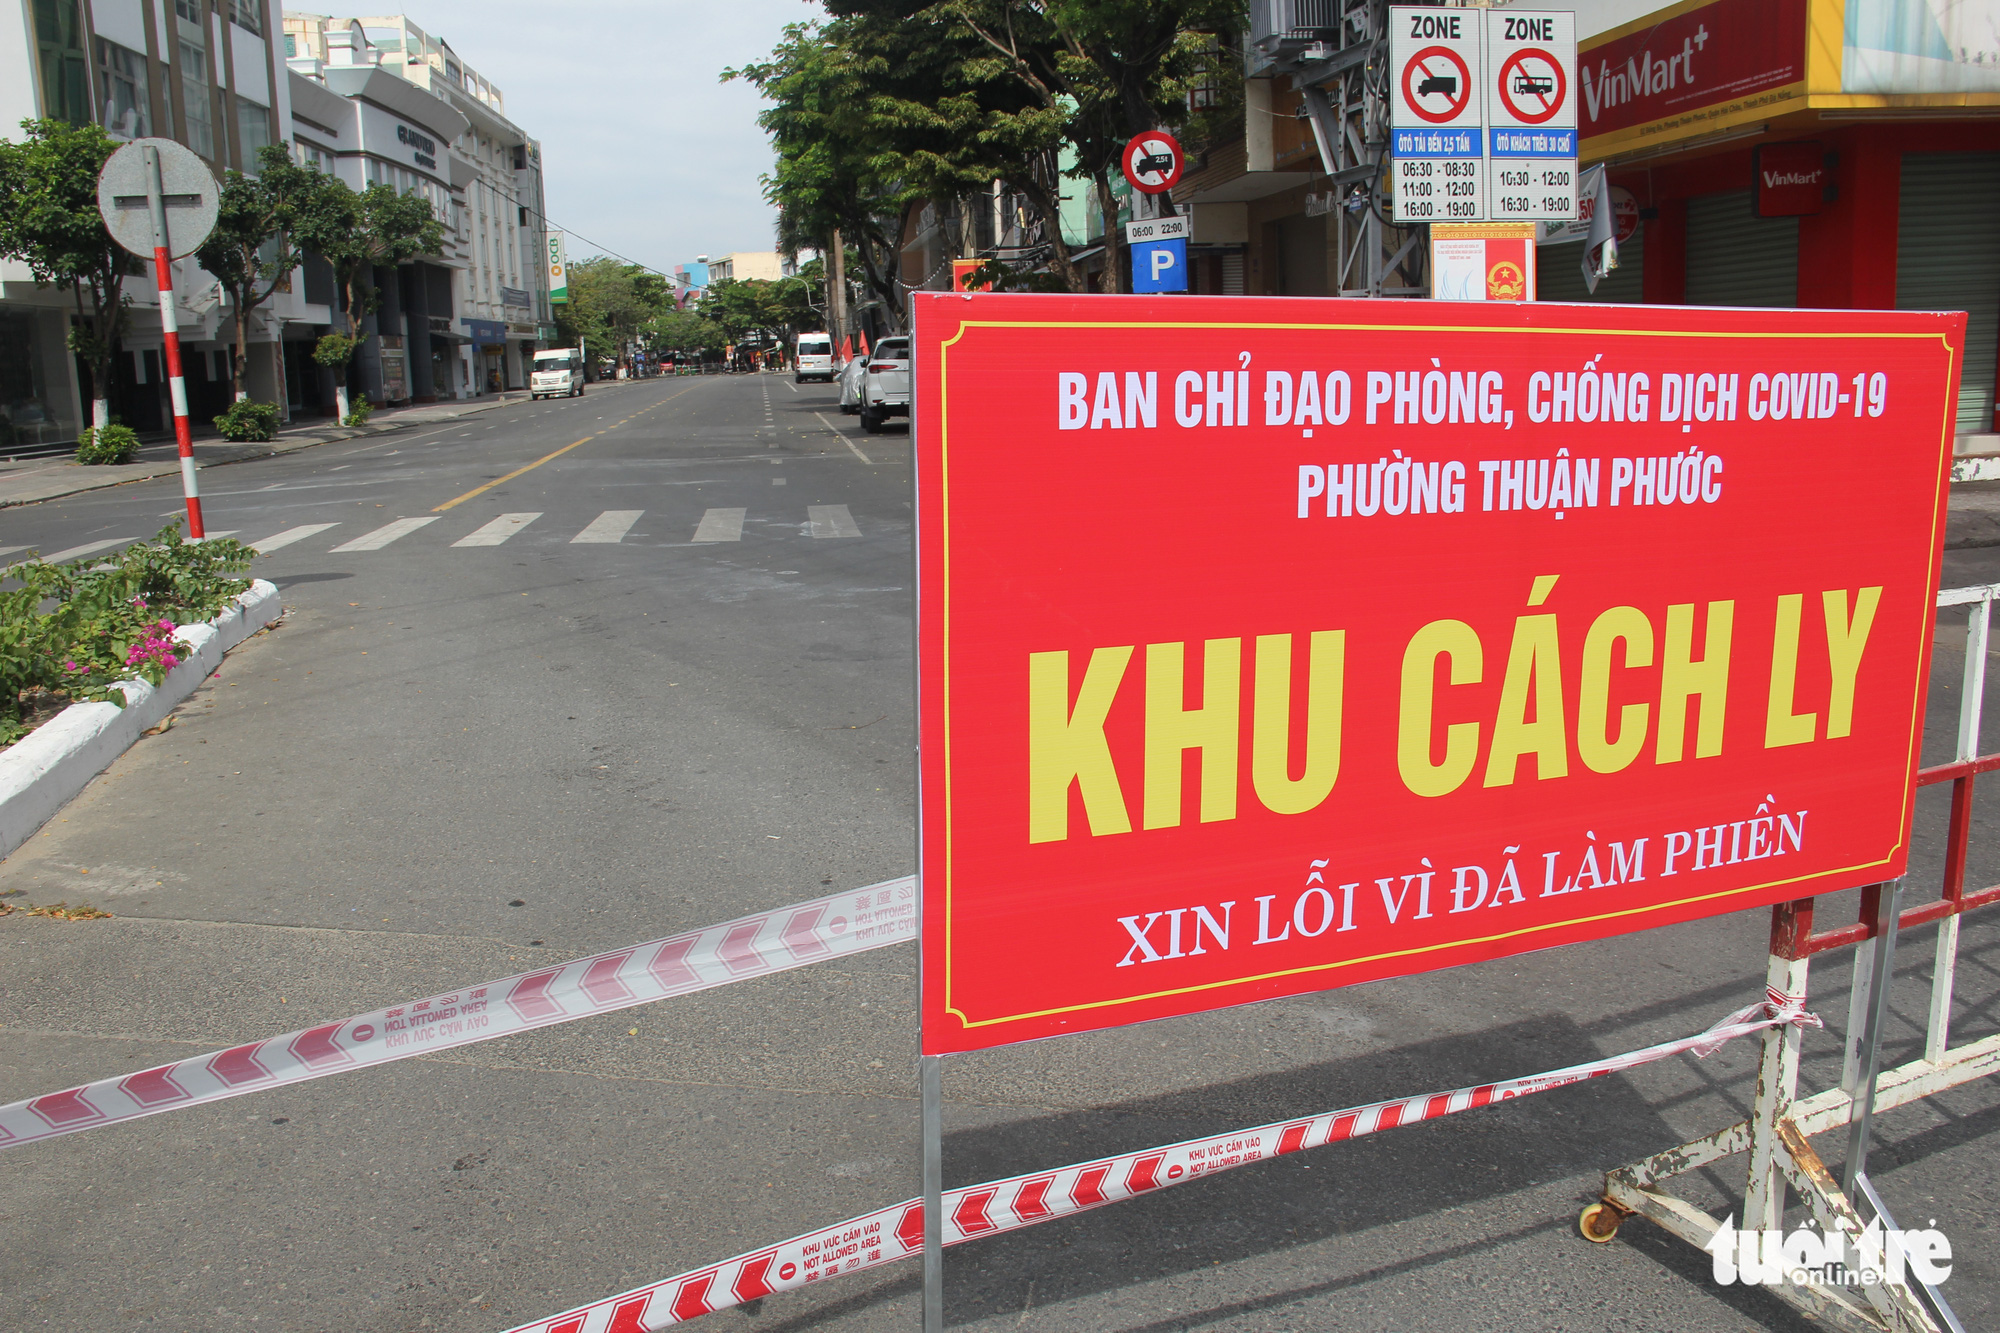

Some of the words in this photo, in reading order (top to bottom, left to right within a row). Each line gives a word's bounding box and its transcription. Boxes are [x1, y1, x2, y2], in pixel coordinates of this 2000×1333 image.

[1411, 15, 1461, 39] ZONE
[1504, 17, 1553, 41] ZONE
[1427, 131, 1442, 152] ĐẾN
[1455, 131, 1470, 152] TẤN
[1510, 133, 1531, 152] KHÁCH
[1532, 133, 1548, 152] TRÊN
[1549, 137, 1557, 152] 30
[1403, 162, 1432, 176] 06:30
[1445, 162, 1475, 176] 08:30
[1541, 171, 1570, 186] 12:00
[1403, 182, 1432, 196] 11:00
[1445, 182, 1475, 196] 12:00
[1403, 202, 1433, 216] 16:00
[1446, 202, 1475, 216] 19:00
[1500, 197, 1529, 211] 16:30
[1541, 197, 1570, 211] 19:00
[1132, 226, 1154, 238] 06:00
[1161, 223, 1182, 234] 22:00
[550, 238, 559, 264] OCB
[1151, 250, 1175, 281] P
[1058, 371, 1157, 430] BAN
[1174, 350, 1251, 428] CHỈ
[1263, 370, 1351, 438] ĐẠO
[1365, 357, 1514, 430] PHÒNG,
[1527, 353, 1649, 424] CHỐNG
[1659, 373, 1738, 433] DỊCH
[1748, 371, 1887, 421] COVID-19
[1297, 449, 1466, 519] PHƯỜNG
[1478, 447, 1599, 520] THUẬN
[1610, 446, 1723, 507] PHƯỚC
[1029, 629, 1346, 845] KHU
[1397, 574, 1735, 798] CÁCH
[1764, 585, 1884, 749] LY
[1115, 900, 1236, 968] XIN
[1252, 858, 1360, 946] LỖI
[1374, 857, 1436, 924] VÌ
[1449, 844, 1526, 914] ĐÃ
[1538, 830, 1650, 898] LÀM
[1660, 793, 1808, 877] PHIỀN
[1188, 1147, 1205, 1161] KHU
[1226, 1138, 1243, 1154] CẤM
[1244, 1135, 1261, 1149] VÀO
[1190, 1161, 1205, 1174] NOT
[1206, 1155, 1241, 1171] ALLOWED
[1242, 1150, 1262, 1163] AREA
[802, 1241, 821, 1257] KHU
[843, 1226, 861, 1244] CẤM
[863, 1220, 881, 1235] VÀO
[803, 1255, 820, 1271] NOT
[822, 1243, 859, 1265] ALLOWED
[860, 1234, 882, 1250] AREA
